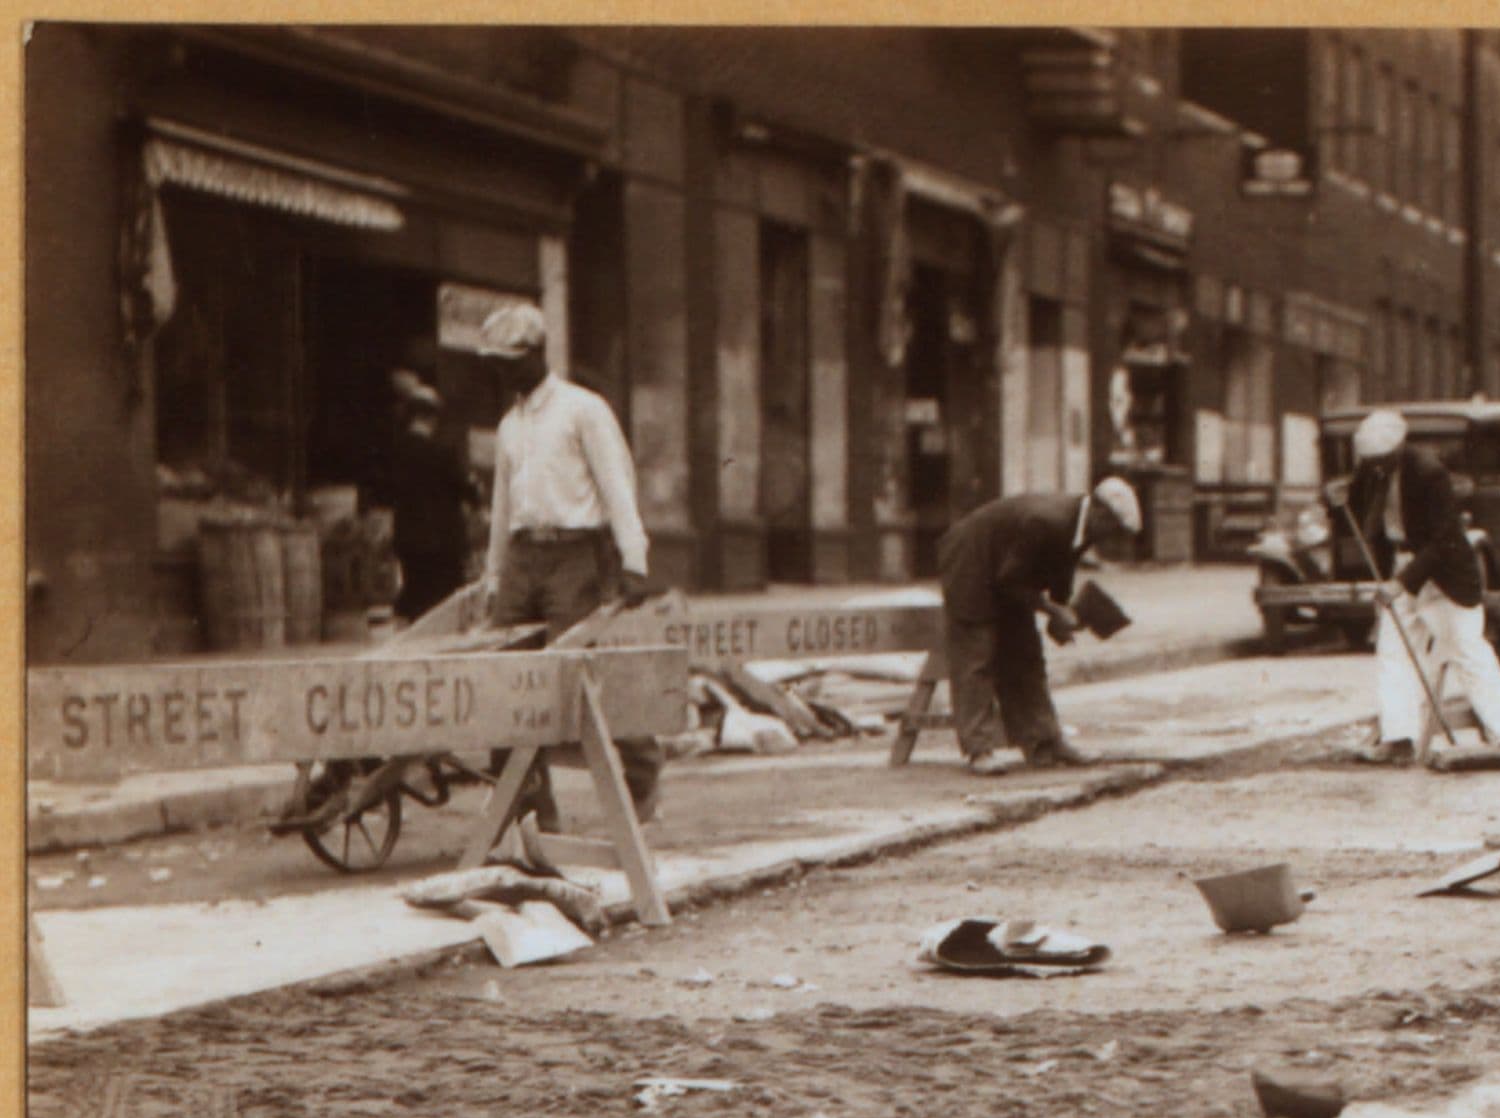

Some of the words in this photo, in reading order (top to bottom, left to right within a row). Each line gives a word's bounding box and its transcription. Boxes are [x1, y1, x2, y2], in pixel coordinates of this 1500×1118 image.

[664, 619, 757, 656] STREET
[786, 615, 877, 651] CLOSED
[62, 689, 247, 749] STREET
[306, 677, 474, 736] CLOSED
